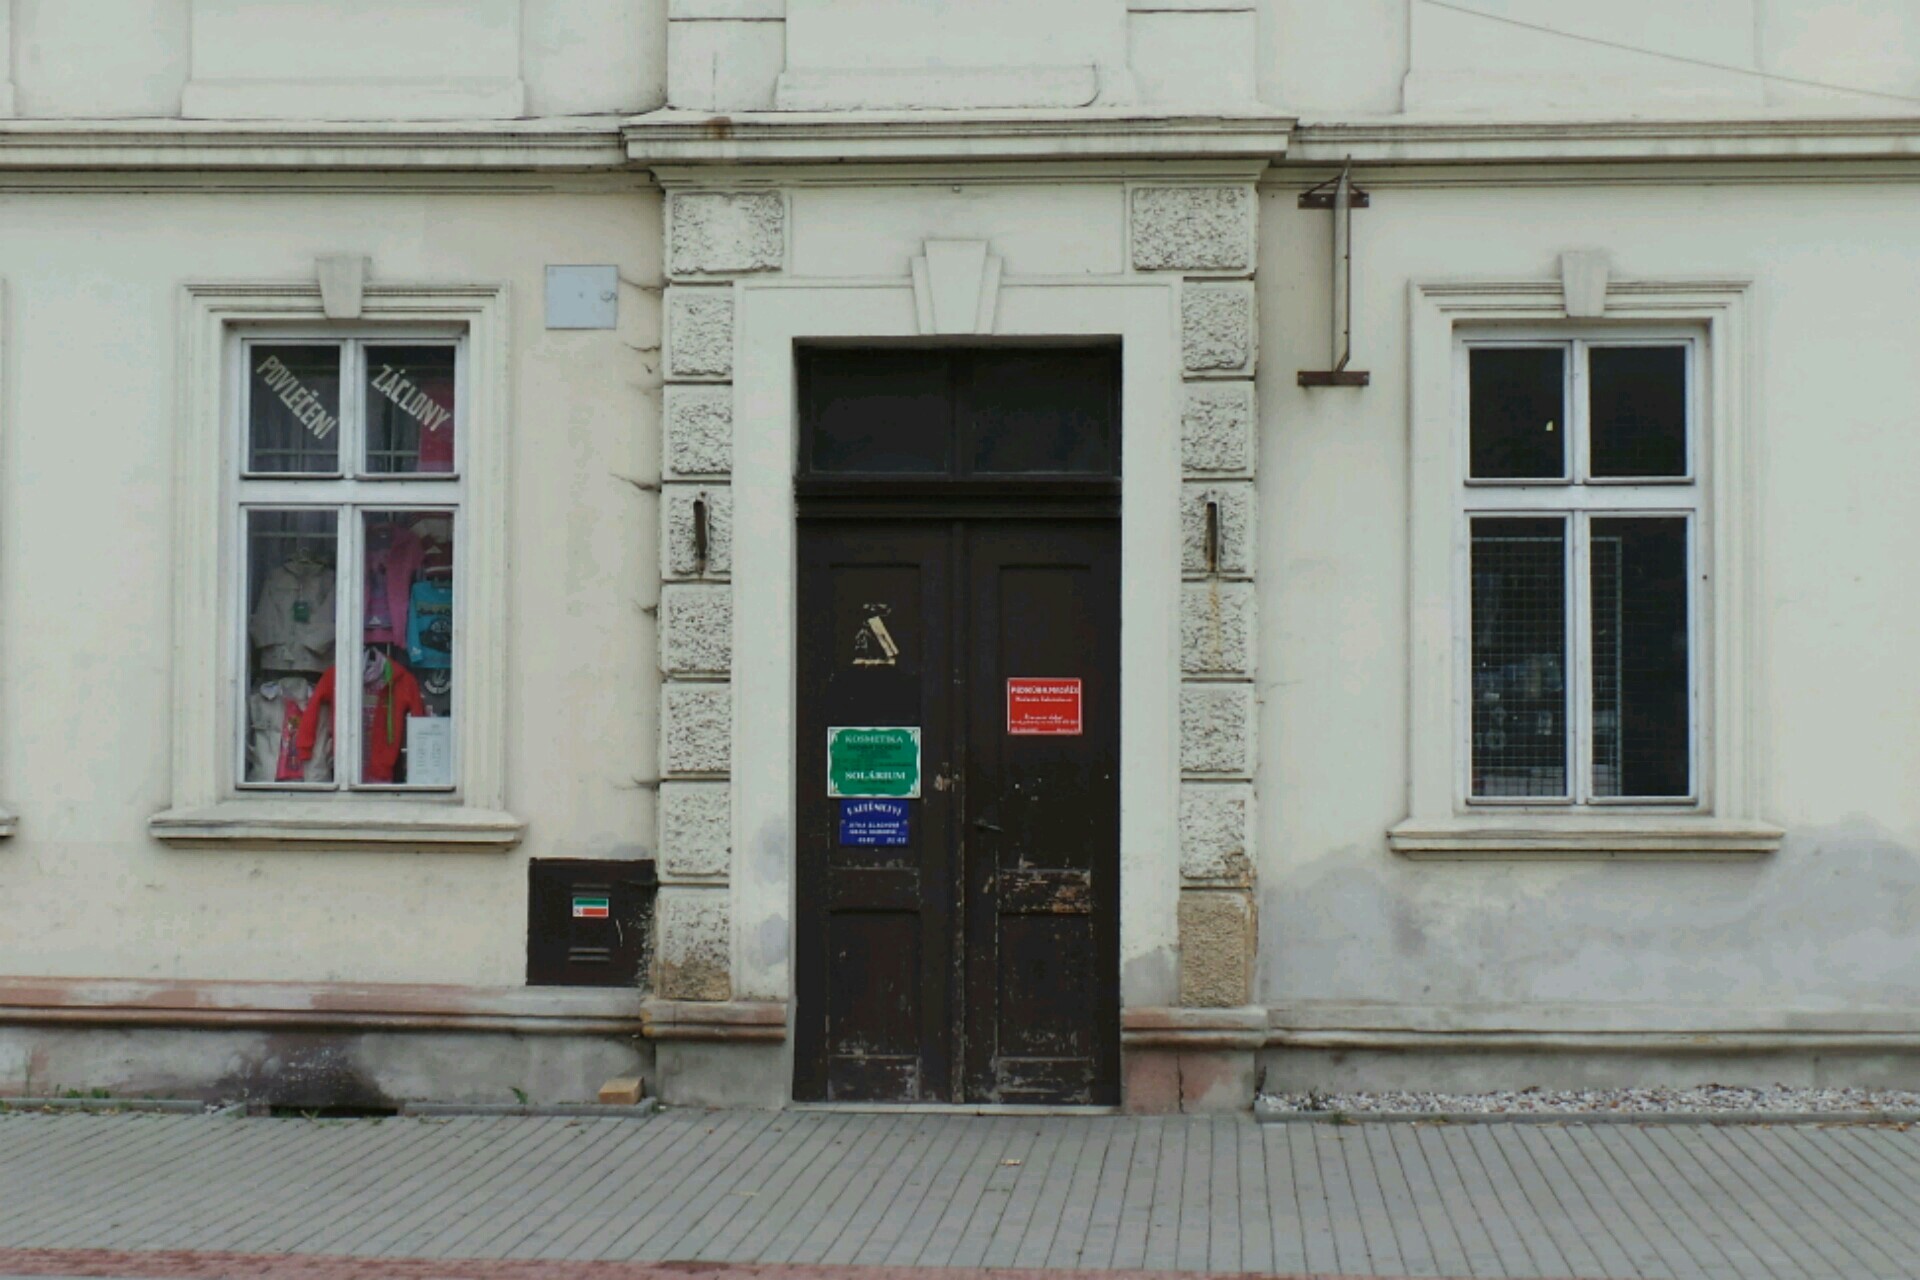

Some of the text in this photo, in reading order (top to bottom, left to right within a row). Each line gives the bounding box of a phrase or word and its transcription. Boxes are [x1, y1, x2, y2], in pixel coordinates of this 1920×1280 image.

[370, 363, 451, 432] ZÁCLONY
[845, 734, 904, 744] KOSMETIKA
[845, 769, 906, 780] SOLÁRIUM
